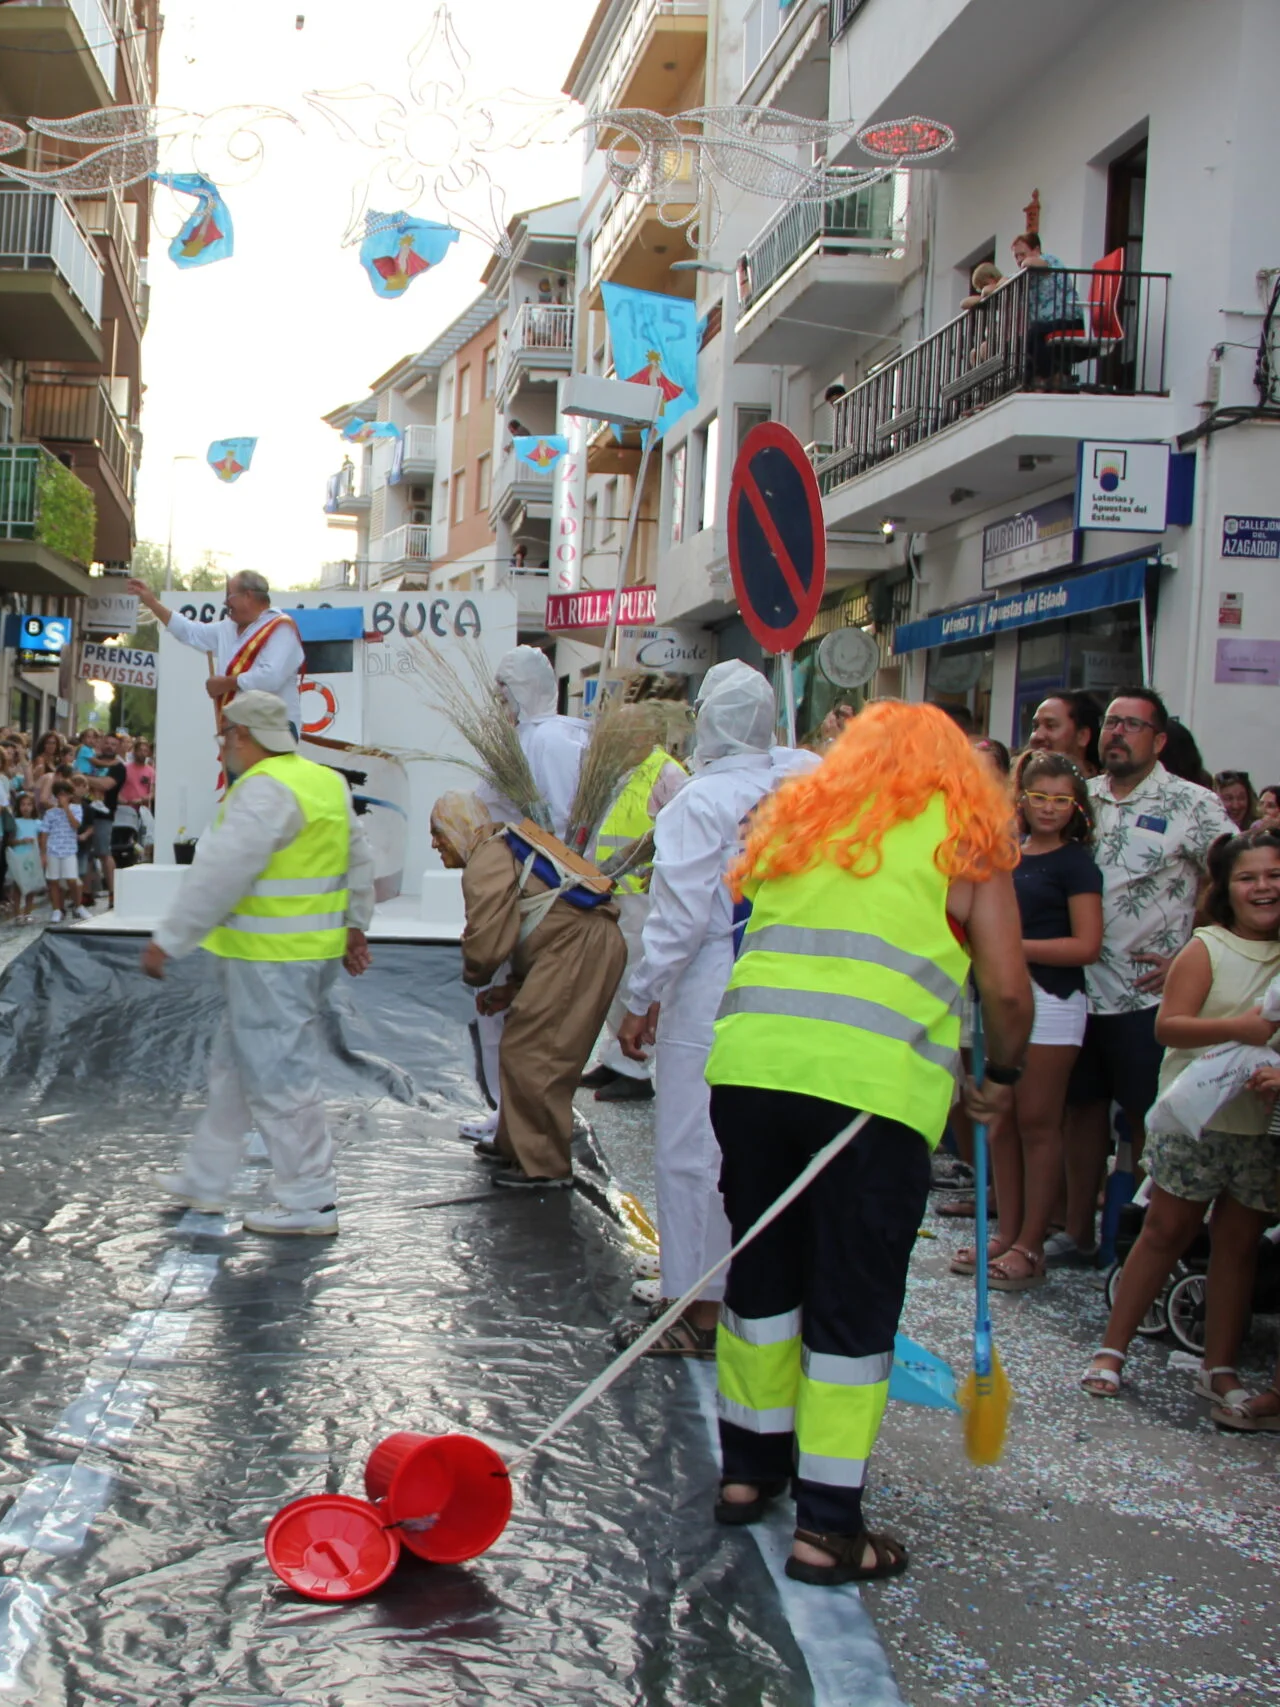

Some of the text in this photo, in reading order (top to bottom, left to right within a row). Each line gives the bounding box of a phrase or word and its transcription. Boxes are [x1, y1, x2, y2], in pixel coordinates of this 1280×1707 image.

[1092, 503, 1147, 514] Apuestas del
[1128, 496, 1134, 505] y
[1091, 513, 1121, 522] Estado
[1223, 538, 1277, 557] AZAGADOR
[547, 600, 565, 627] LA
[568, 594, 613, 626] RULLA
[1024, 592, 1038, 615] del
[1038, 586, 1069, 611] Estado
[42, 621, 66, 650] S
[83, 643, 156, 668] PRENSA
[636, 638, 710, 668] Cande
[81, 662, 155, 687] REVISTAS
